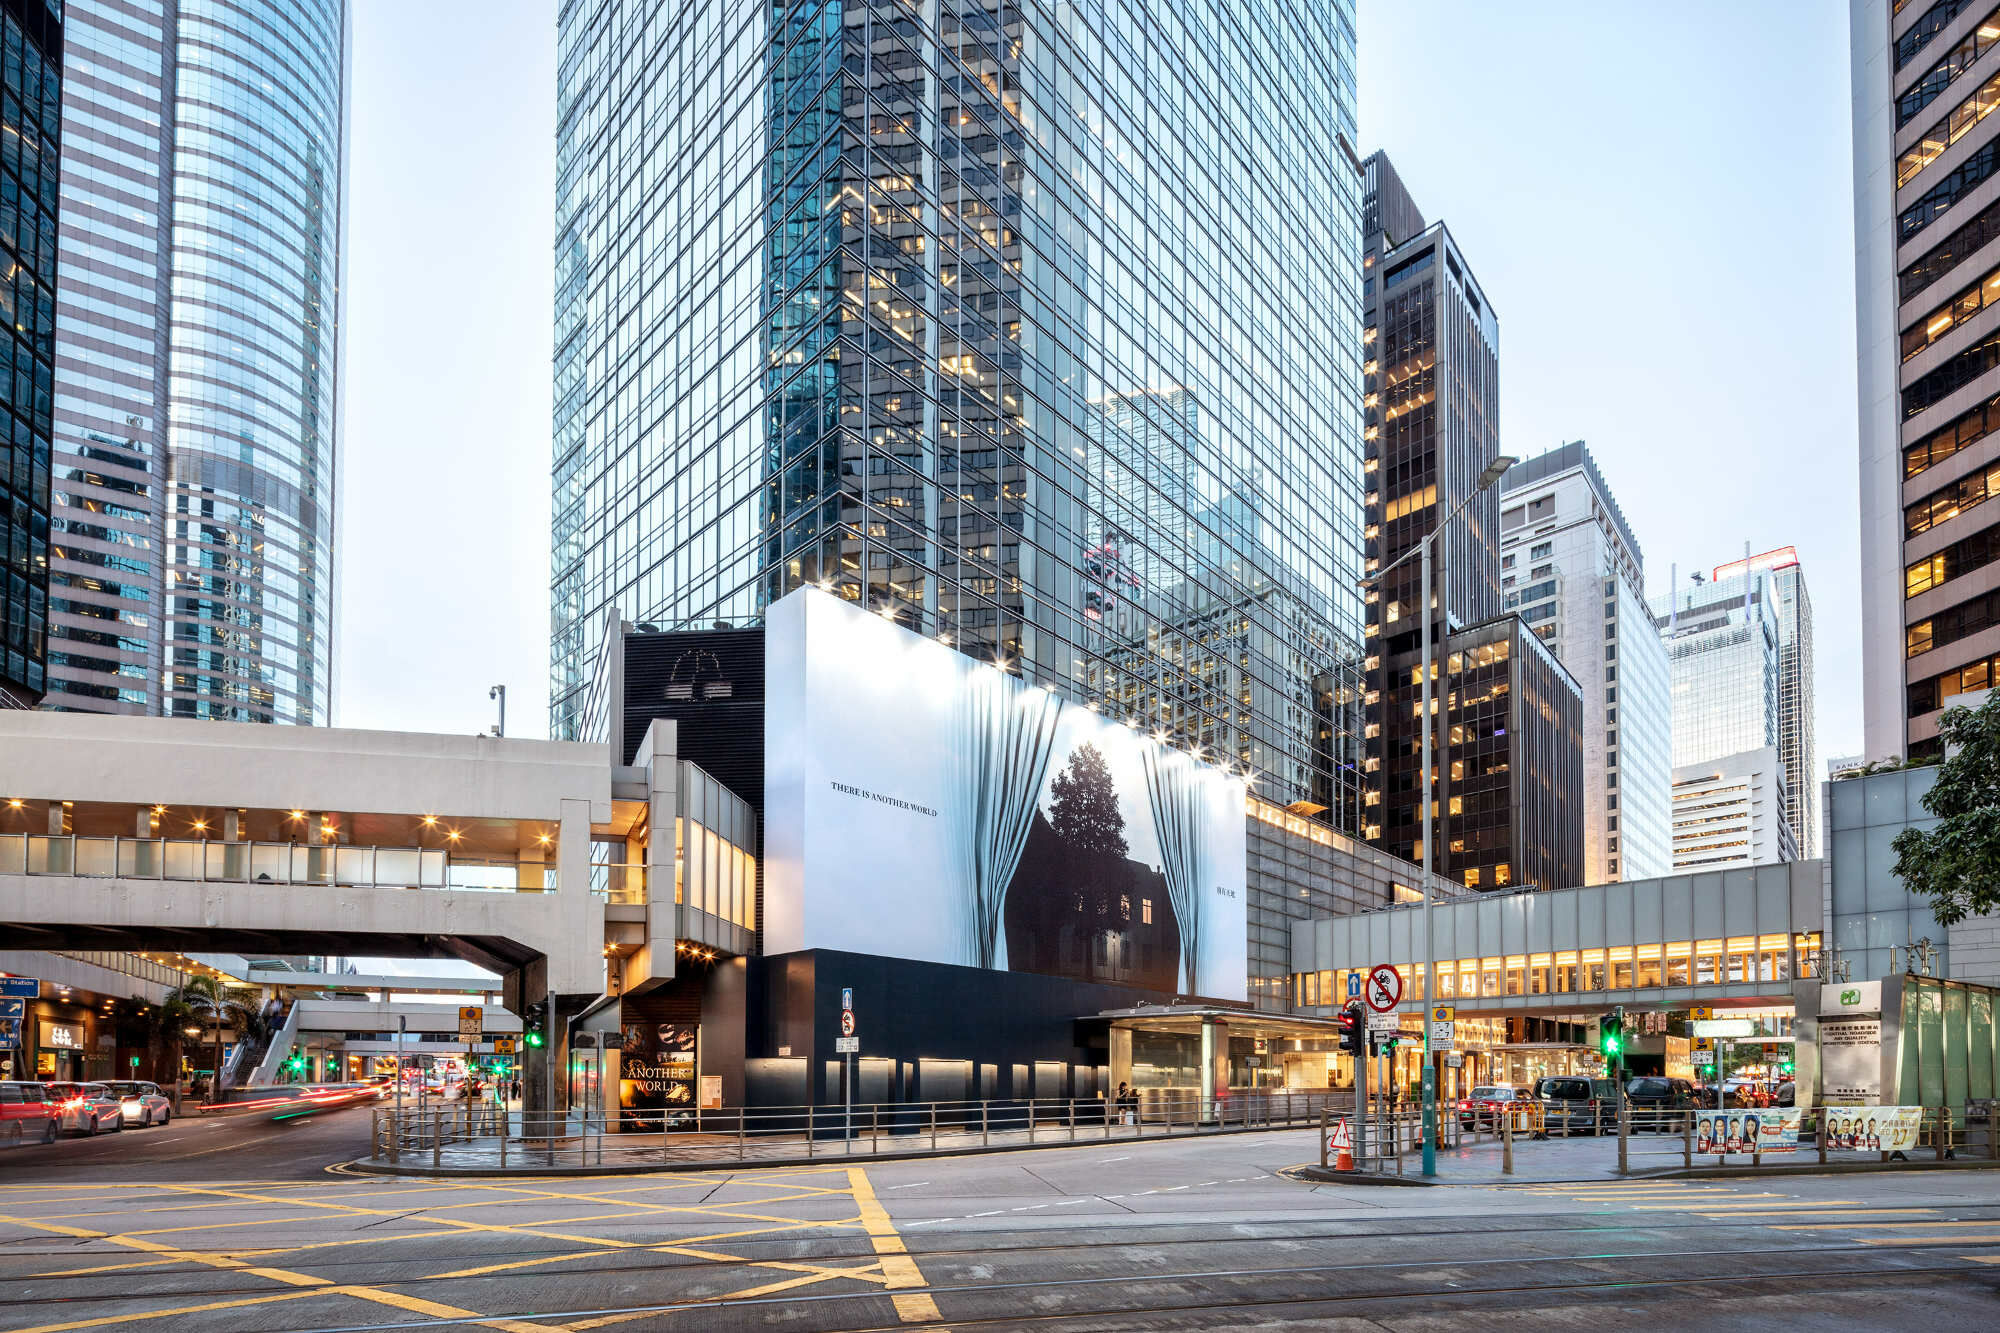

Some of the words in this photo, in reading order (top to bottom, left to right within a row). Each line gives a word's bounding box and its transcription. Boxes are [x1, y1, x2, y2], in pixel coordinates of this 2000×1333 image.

[831, 782, 860, 796] THERE
[862, 790, 870, 800] IS
[872, 793, 909, 810] ANOTHER
[910, 803, 938, 817] WORLD
[628, 1067, 686, 1078] ANOTHER
[635, 1081, 681, 1091] WORLD
[1892, 1128, 1908, 1146] 27
